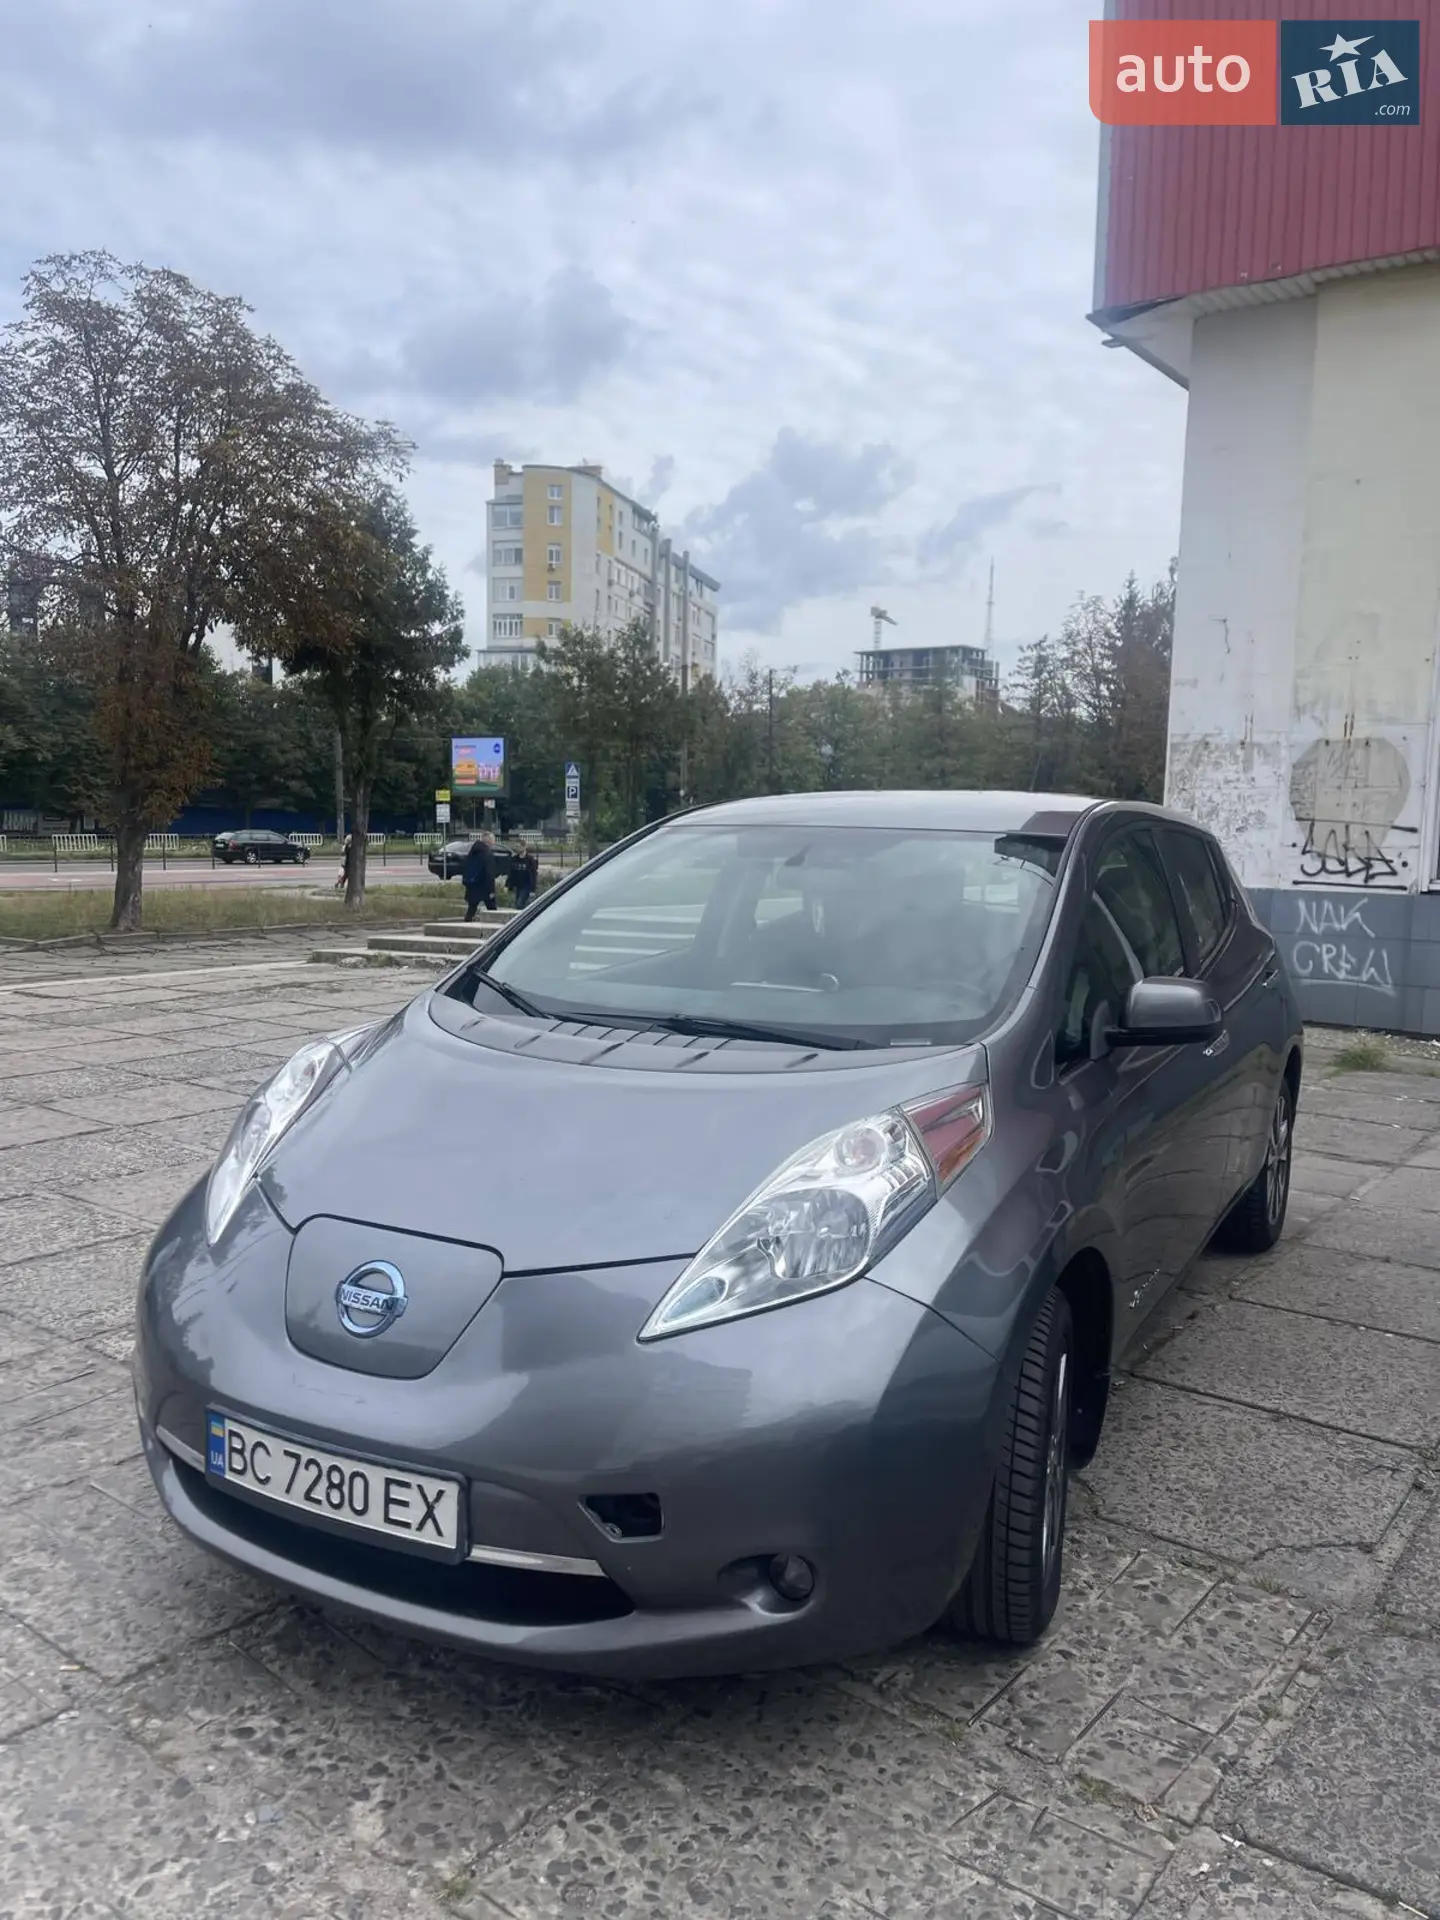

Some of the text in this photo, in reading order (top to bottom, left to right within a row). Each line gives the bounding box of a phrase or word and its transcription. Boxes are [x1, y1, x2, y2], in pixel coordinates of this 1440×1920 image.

[569, 786, 577, 798] P
[340, 1287, 394, 1311] NISSAN
[210, 1450, 224, 1468] UA
[228, 1428, 445, 1537] BC 7280 EX
